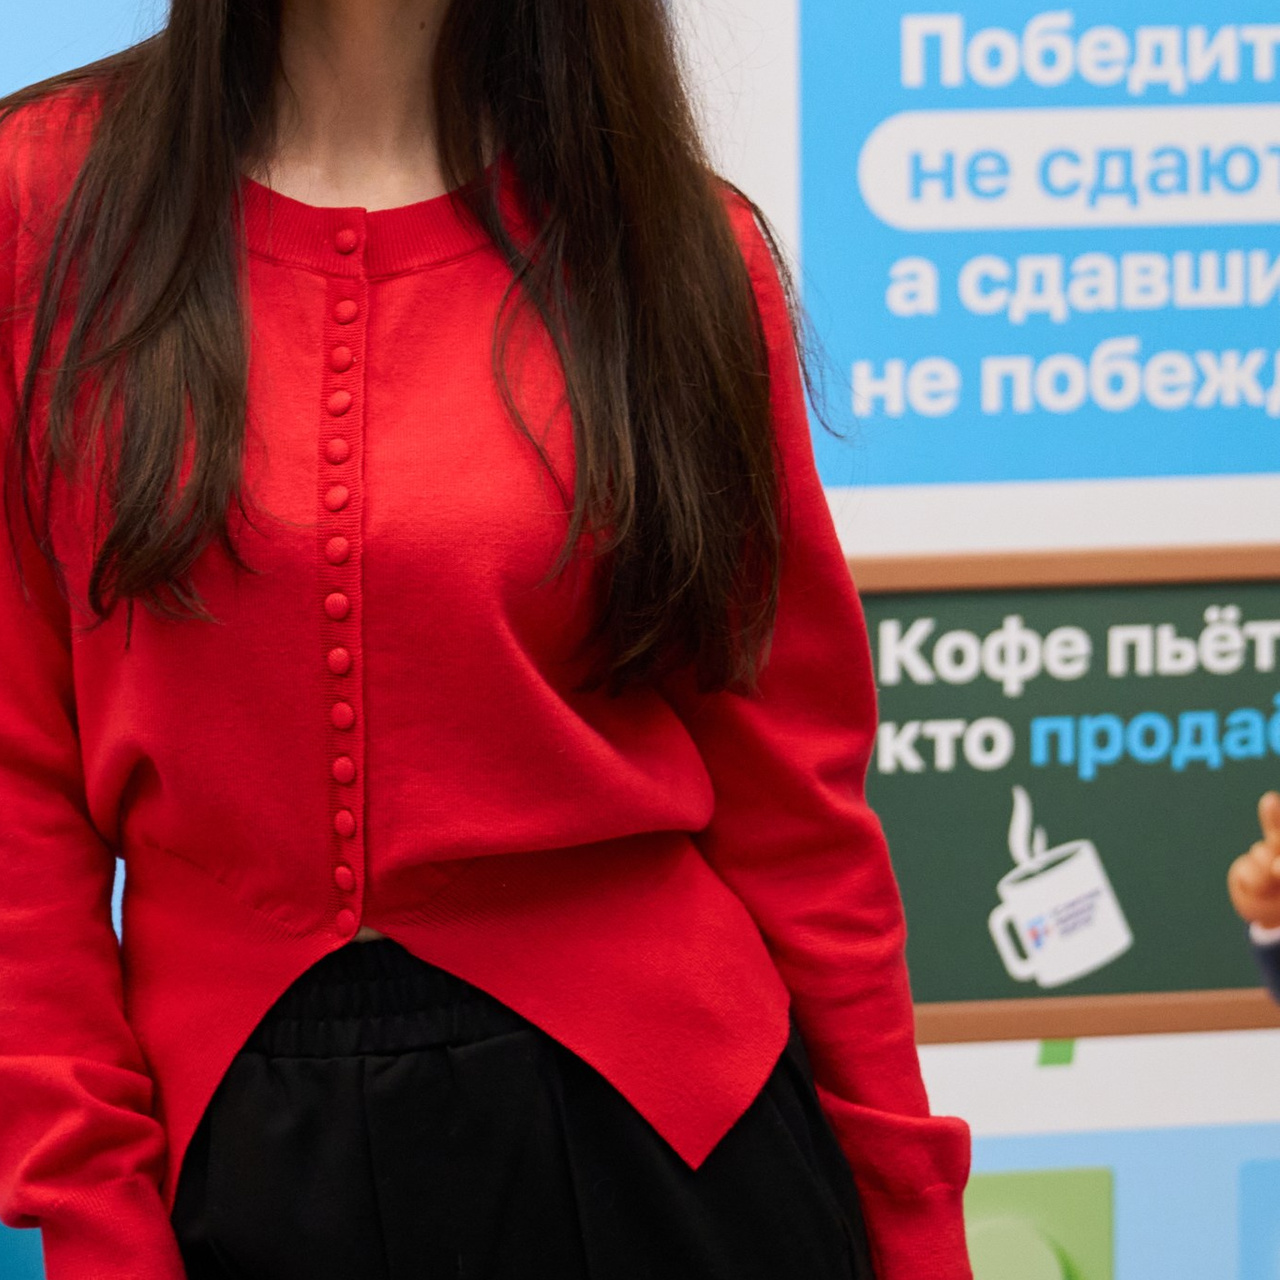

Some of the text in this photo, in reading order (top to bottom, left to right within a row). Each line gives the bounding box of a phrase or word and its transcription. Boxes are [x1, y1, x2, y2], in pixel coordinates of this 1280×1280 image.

[900, 11, 1280, 95] Победит
[909, 149, 1011, 200] не
[885, 250, 1280, 324] а сдавши
[851, 336, 1280, 418] не побеж
[878, 604, 1280, 697] Кофе пьёт
[877, 693, 1280, 780] кто прода
